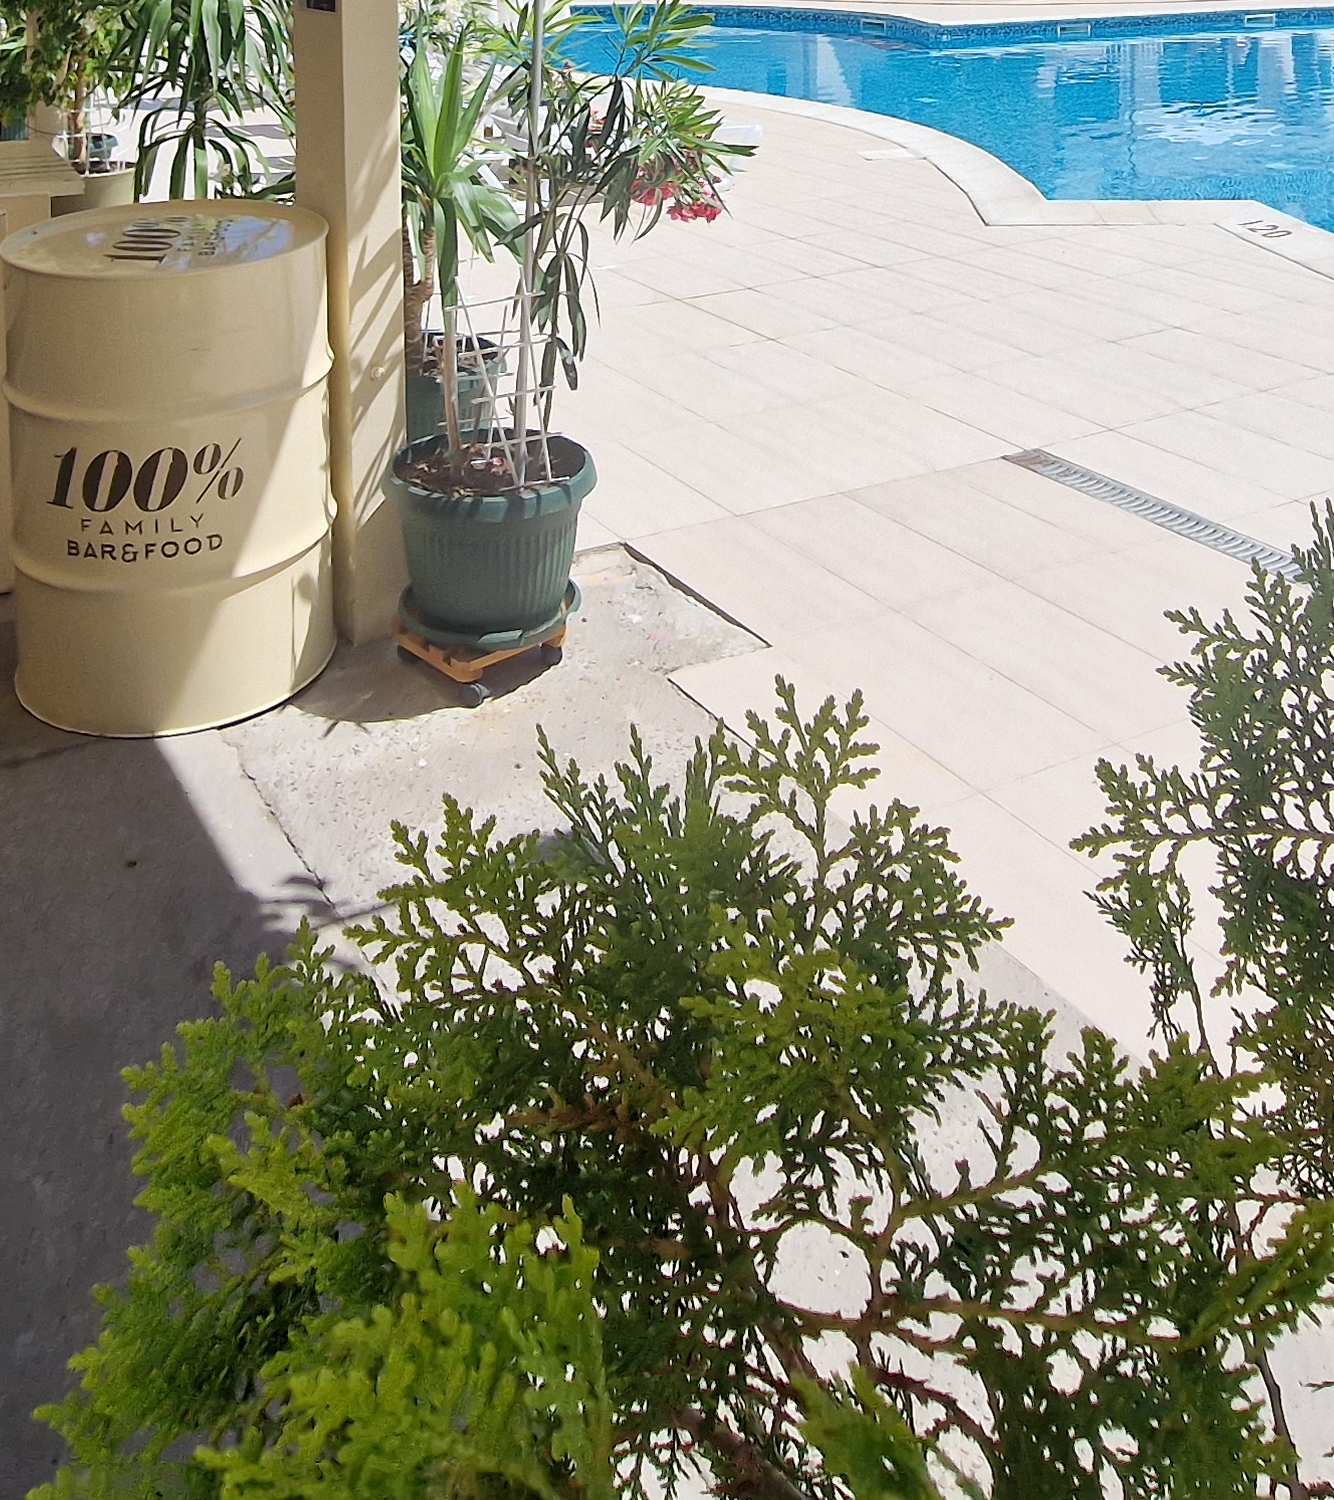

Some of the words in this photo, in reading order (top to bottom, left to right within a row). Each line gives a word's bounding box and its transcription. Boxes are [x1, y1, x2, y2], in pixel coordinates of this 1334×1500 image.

[46, 438, 244, 513] 100%
[80, 513, 205, 535] FAMILY
[67, 534, 223, 563] BAR&FOOD
